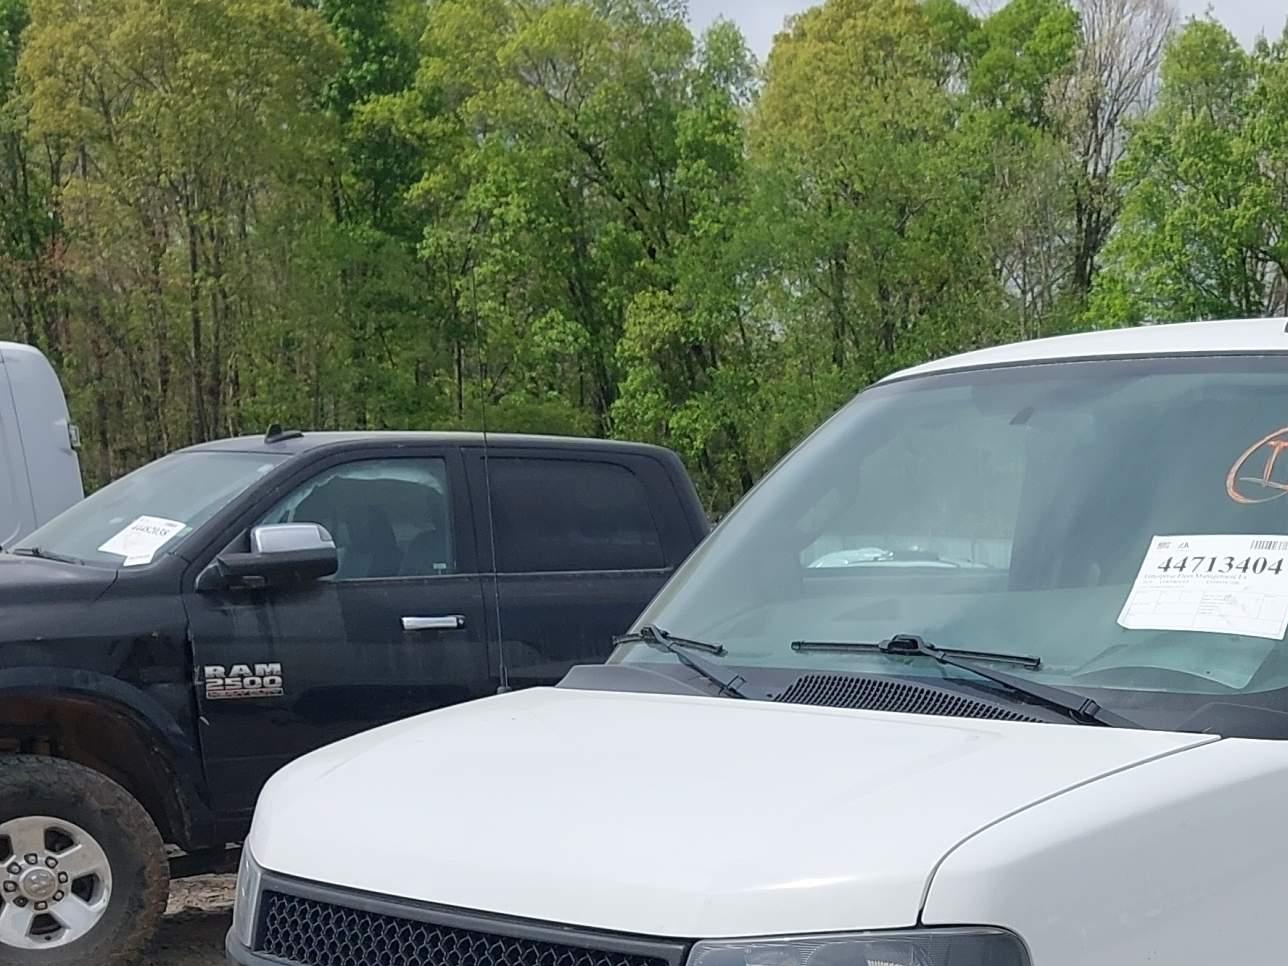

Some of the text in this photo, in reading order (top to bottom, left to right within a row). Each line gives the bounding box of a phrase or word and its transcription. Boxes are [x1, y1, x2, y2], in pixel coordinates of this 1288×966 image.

[1157, 555, 1285, 575] 44713404
[204, 663, 282, 678] RAM
[206, 676, 283, 690] 2500
